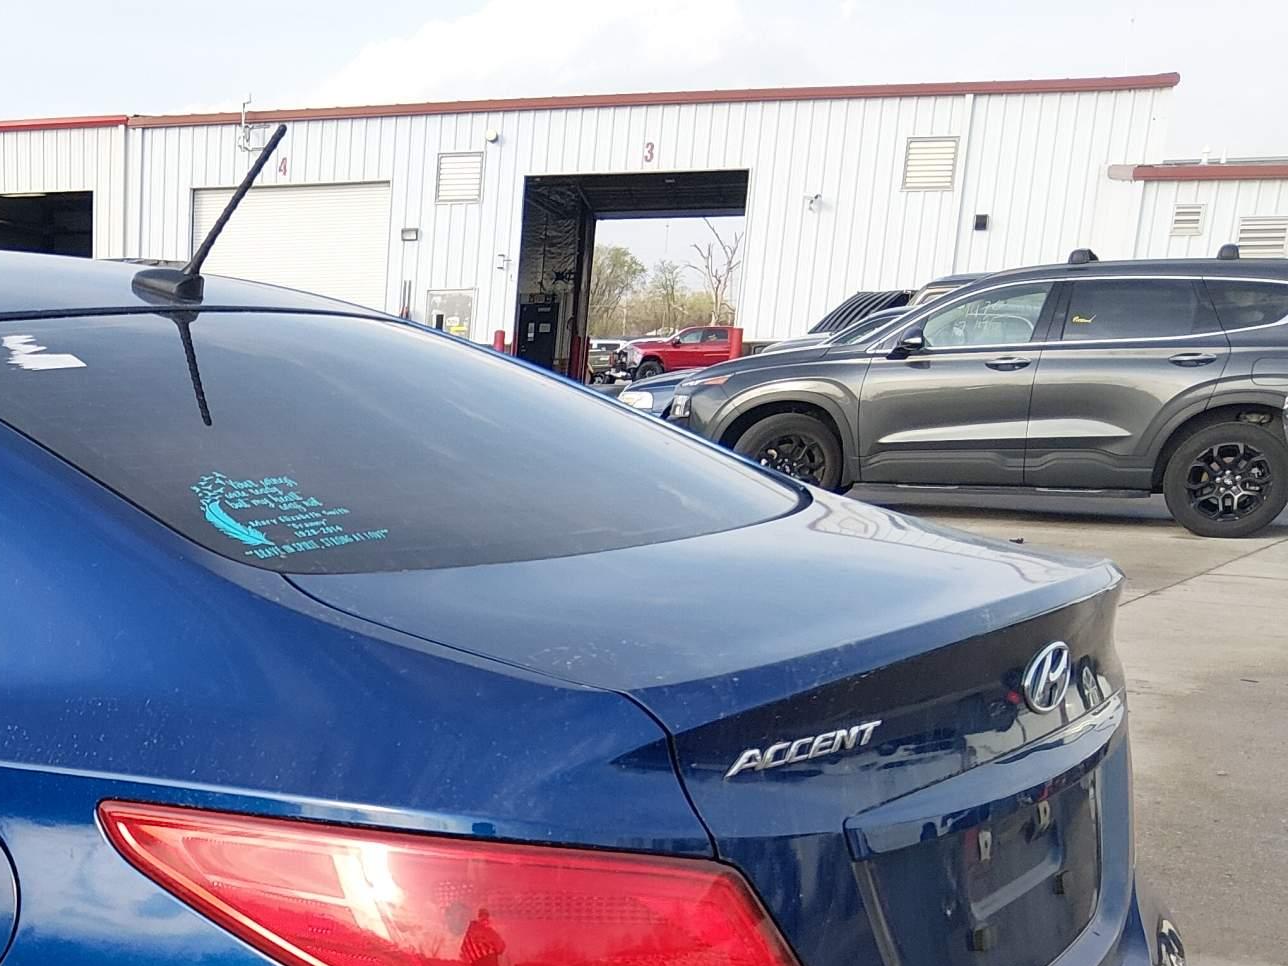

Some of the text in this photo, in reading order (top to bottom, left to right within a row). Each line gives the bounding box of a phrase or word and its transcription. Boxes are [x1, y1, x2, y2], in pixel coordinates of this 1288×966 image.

[644, 142, 655, 163] 3
[278, 156, 288, 177] 4
[725, 720, 882, 778] ACCENT
